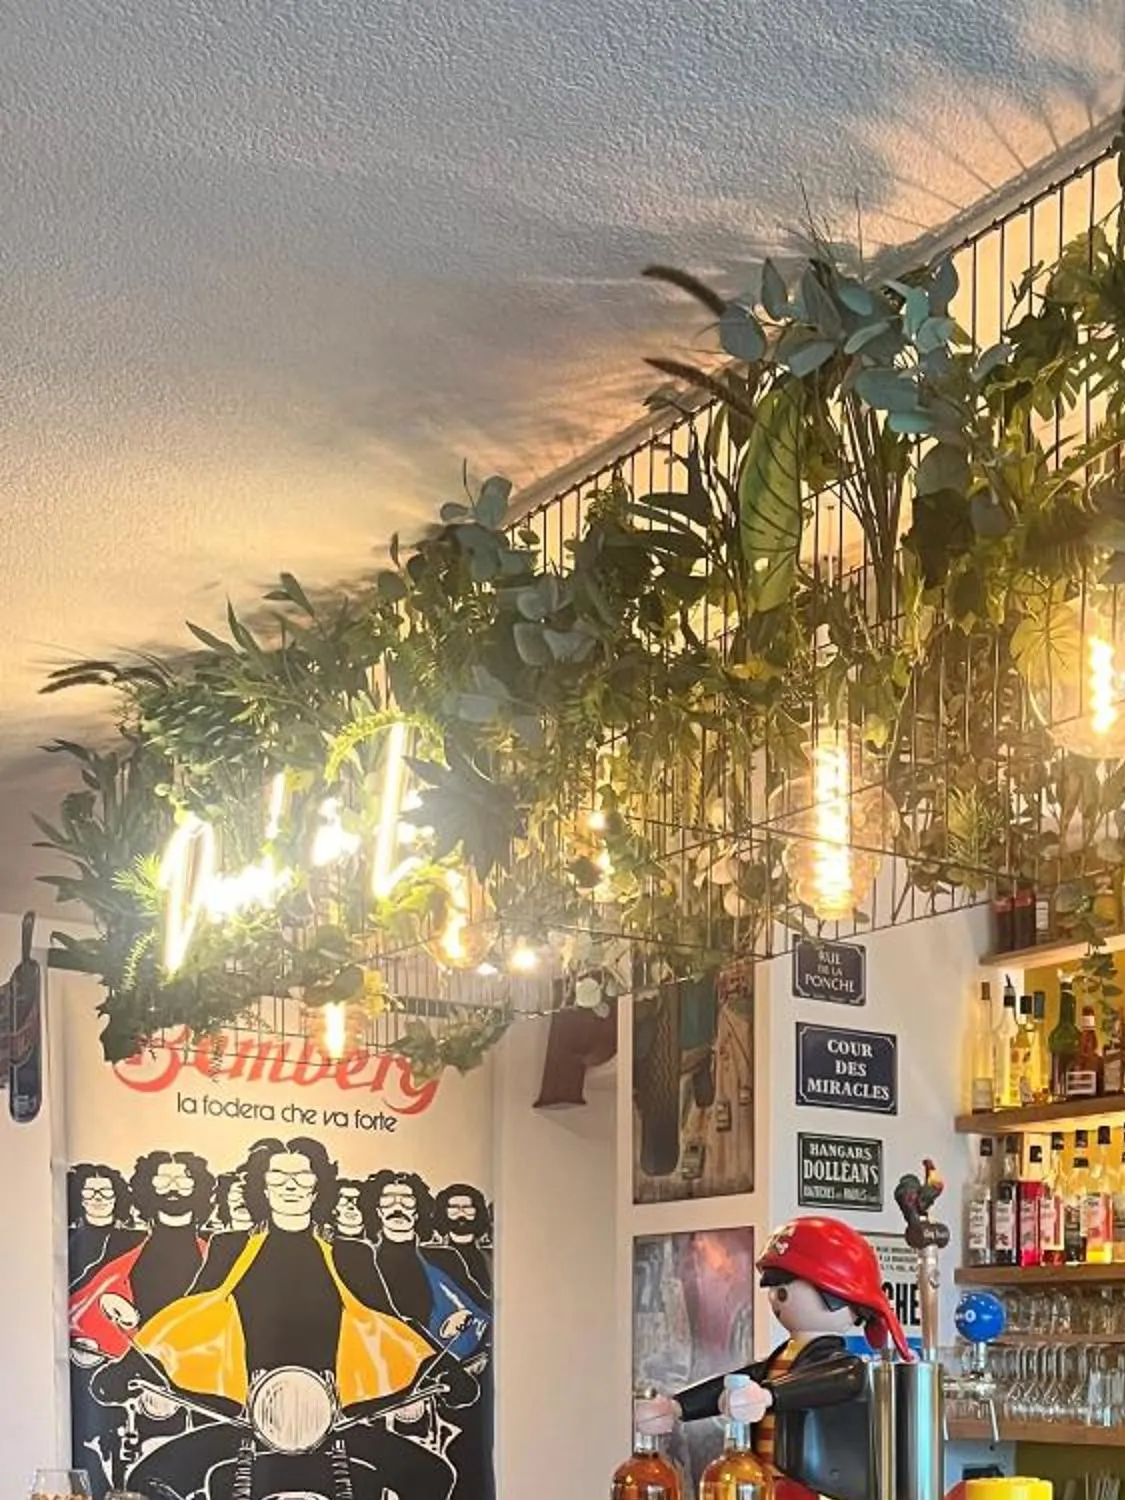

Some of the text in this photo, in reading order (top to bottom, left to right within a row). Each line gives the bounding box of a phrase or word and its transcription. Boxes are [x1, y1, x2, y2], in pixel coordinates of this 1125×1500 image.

[805, 973, 855, 993] PONCHE
[827, 1039, 873, 1058] COUR
[835, 1060, 867, 1077] DES
[807, 1077, 890, 1101] MIRACLES
[176, 1091, 398, 1133] la fodera che va forte
[809, 1143, 873, 1160] HANGARS
